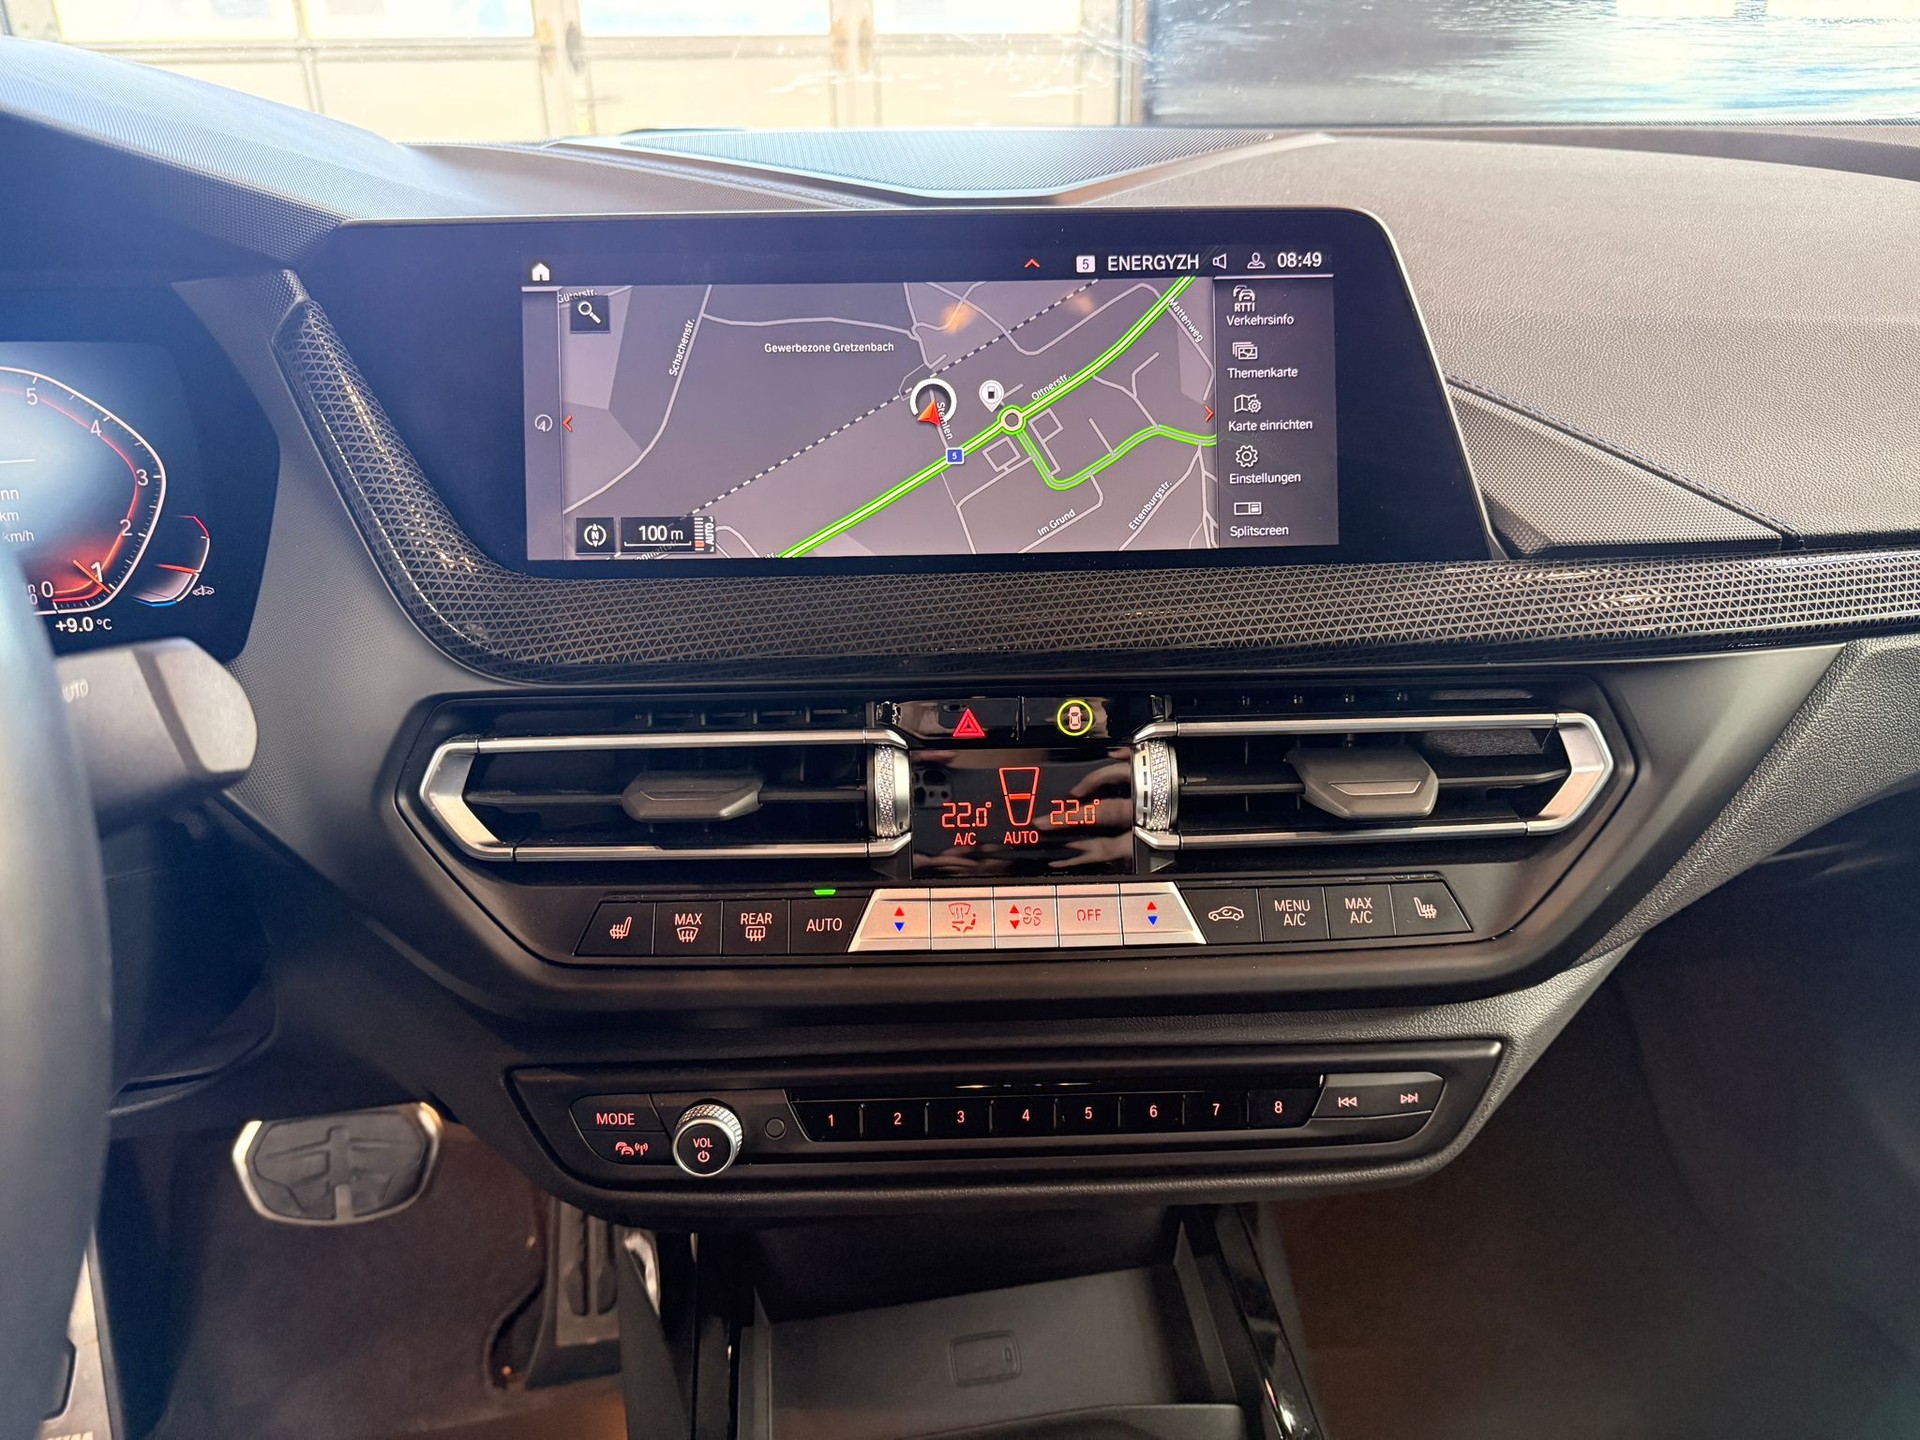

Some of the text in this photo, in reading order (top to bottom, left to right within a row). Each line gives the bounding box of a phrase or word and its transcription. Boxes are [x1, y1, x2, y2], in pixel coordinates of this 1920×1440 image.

[1107, 254, 1200, 271] ENERGYZH
[1277, 252, 1322, 268] 08:49
[1234, 302, 1255, 312] RTTI
[1169, 297, 1204, 343] Mattenweg
[1226, 313, 1295, 326] Verkehrsinfo
[668, 318, 696, 377] Schachenstr.
[764, 342, 894, 353] Gewerbezone Gretzenbach
[1227, 367, 1298, 379] Themenkarte
[1031, 373, 1071, 401] Oltnerstr.
[26, 388, 38, 405] 5
[90, 420, 102, 437] 4
[1228, 419, 1313, 432] Karte einrichten
[136, 469, 149, 486] 3
[1229, 473, 1302, 485] Einstellungen
[1128, 480, 1173, 531] Ettenburgstr.
[120, 519, 132, 536] 2
[1037, 509, 1076, 536] Im Grund
[638, 525, 684, 541] 100 m
[705, 522, 715, 545] AUTO
[1230, 526, 1289, 538] Splitscreen
[91, 561, 103, 583] 1
[41, 581, 54, 598] 0
[55, 617, 112, 633] +9.0 °C
[62, 679, 89, 702] UTO
[954, 833, 977, 846] A/C
[1003, 831, 1039, 845] AUTO
[1274, 900, 1311, 914] MENU
[1345, 898, 1373, 910] MAX
[674, 913, 702, 927] MAX
[740, 912, 773, 926] REAR
[1076, 908, 1102, 922] OFF
[1283, 913, 1307, 927] A/C
[1350, 910, 1374, 925] A/C
[806, 918, 843, 933] AUTO
[1084, 1106, 1094, 1120] 5
[1148, 1105, 1158, 1118] 6
[1211, 1103, 1221, 1117] 7
[1274, 1101, 1284, 1114] 8
[596, 1113, 635, 1126] MODE
[827, 1114, 835, 1127] 1
[893, 1112, 902, 1125] 2
[956, 1110, 966, 1123] 3
[1021, 1108, 1031, 1122] 4
[693, 1138, 713, 1148] VOL
